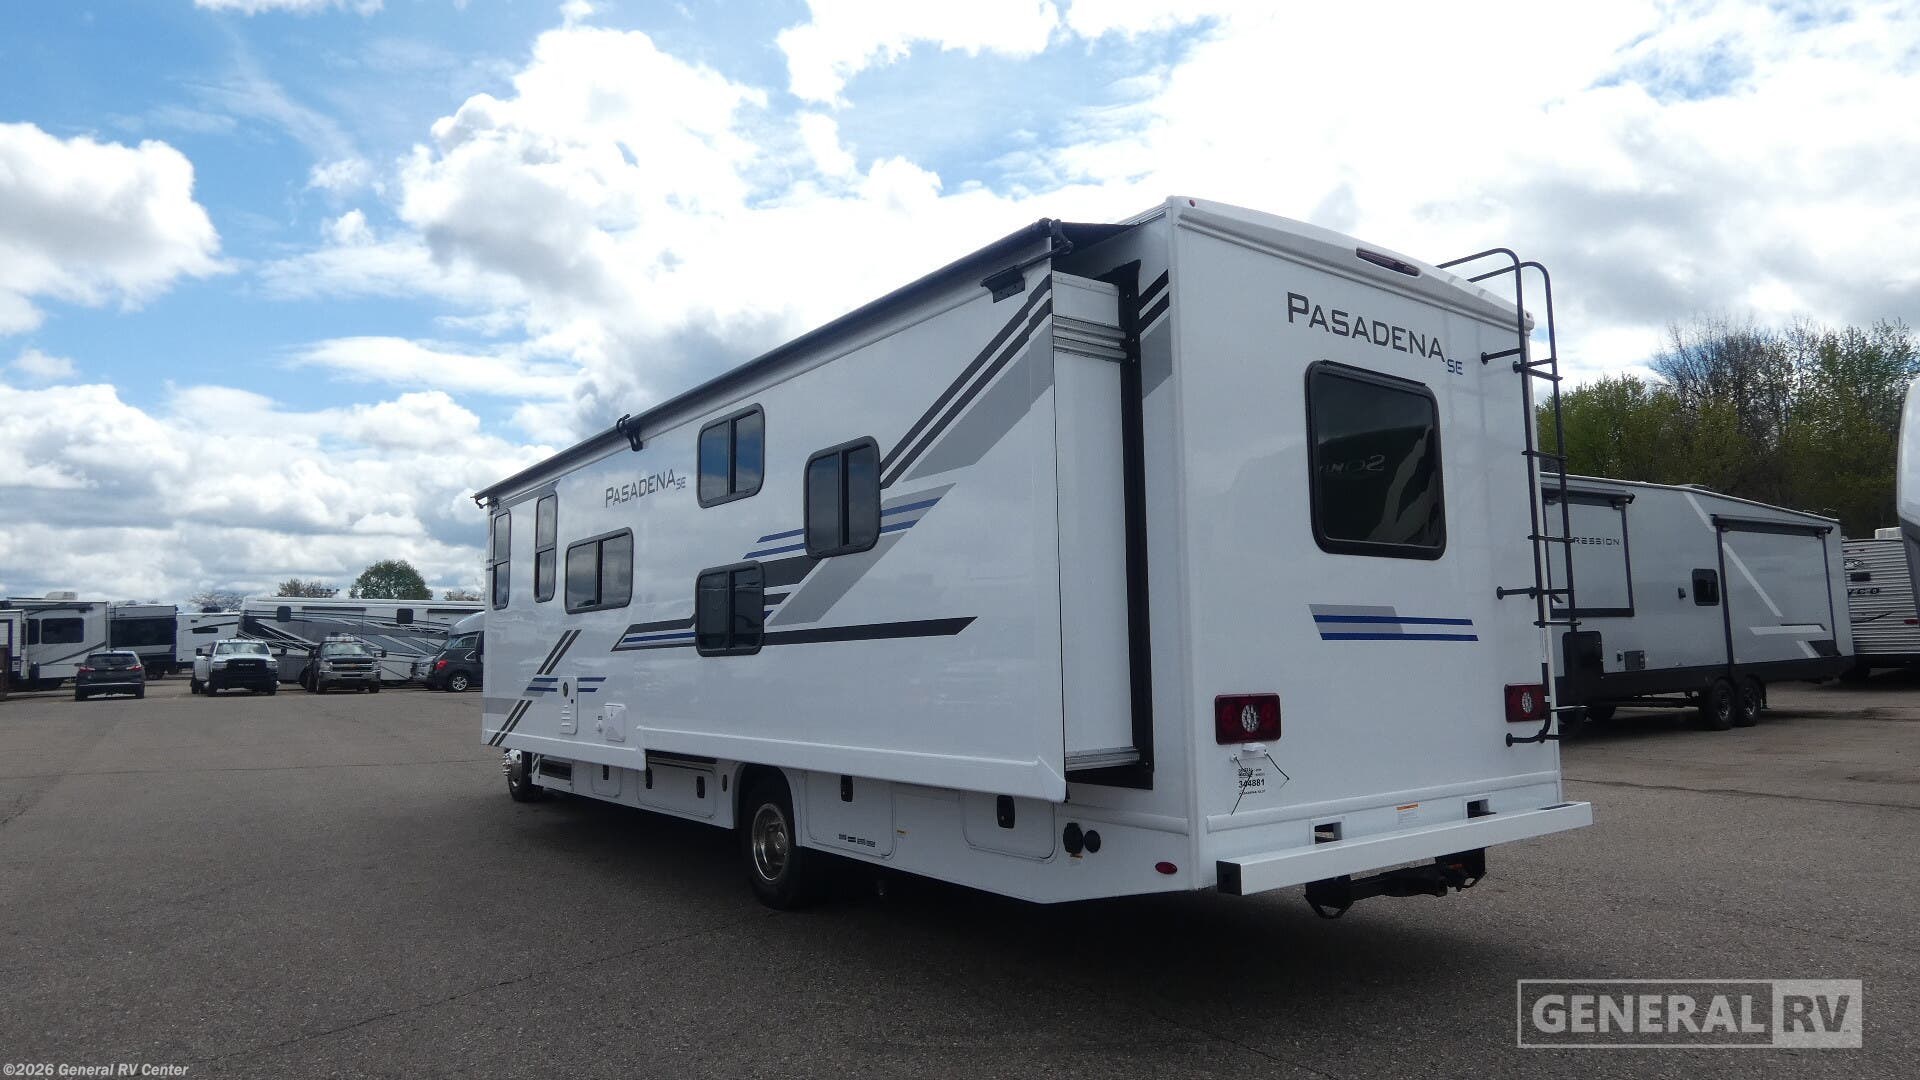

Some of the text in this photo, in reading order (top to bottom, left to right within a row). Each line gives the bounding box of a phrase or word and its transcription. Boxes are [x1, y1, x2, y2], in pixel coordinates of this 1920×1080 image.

[1287, 291, 1464, 376] PASADENA SE
[605, 468, 676, 509] PASADENA
[1573, 536, 1621, 546] RESSION
